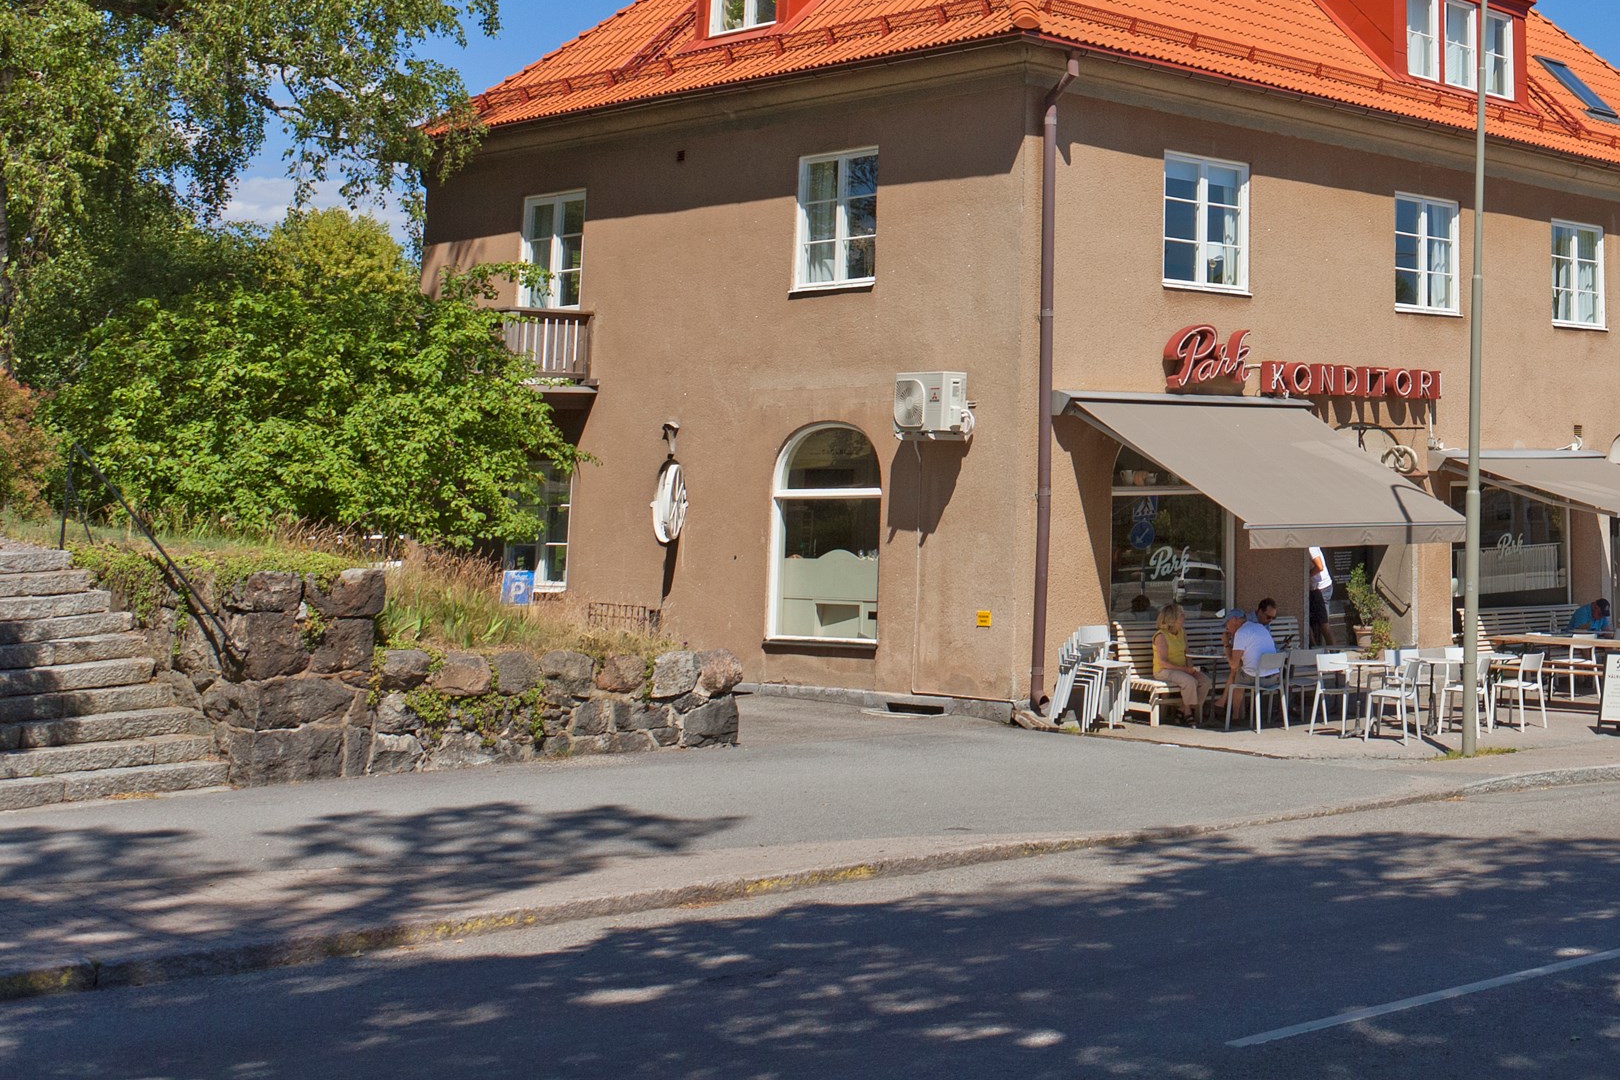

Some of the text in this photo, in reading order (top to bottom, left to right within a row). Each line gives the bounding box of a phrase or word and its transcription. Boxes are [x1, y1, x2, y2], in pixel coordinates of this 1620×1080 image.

[1163, 324, 1443, 400] Park KONDITORI
[1149, 545, 1190, 580] Park
[1497, 532, 1523, 560] Park
